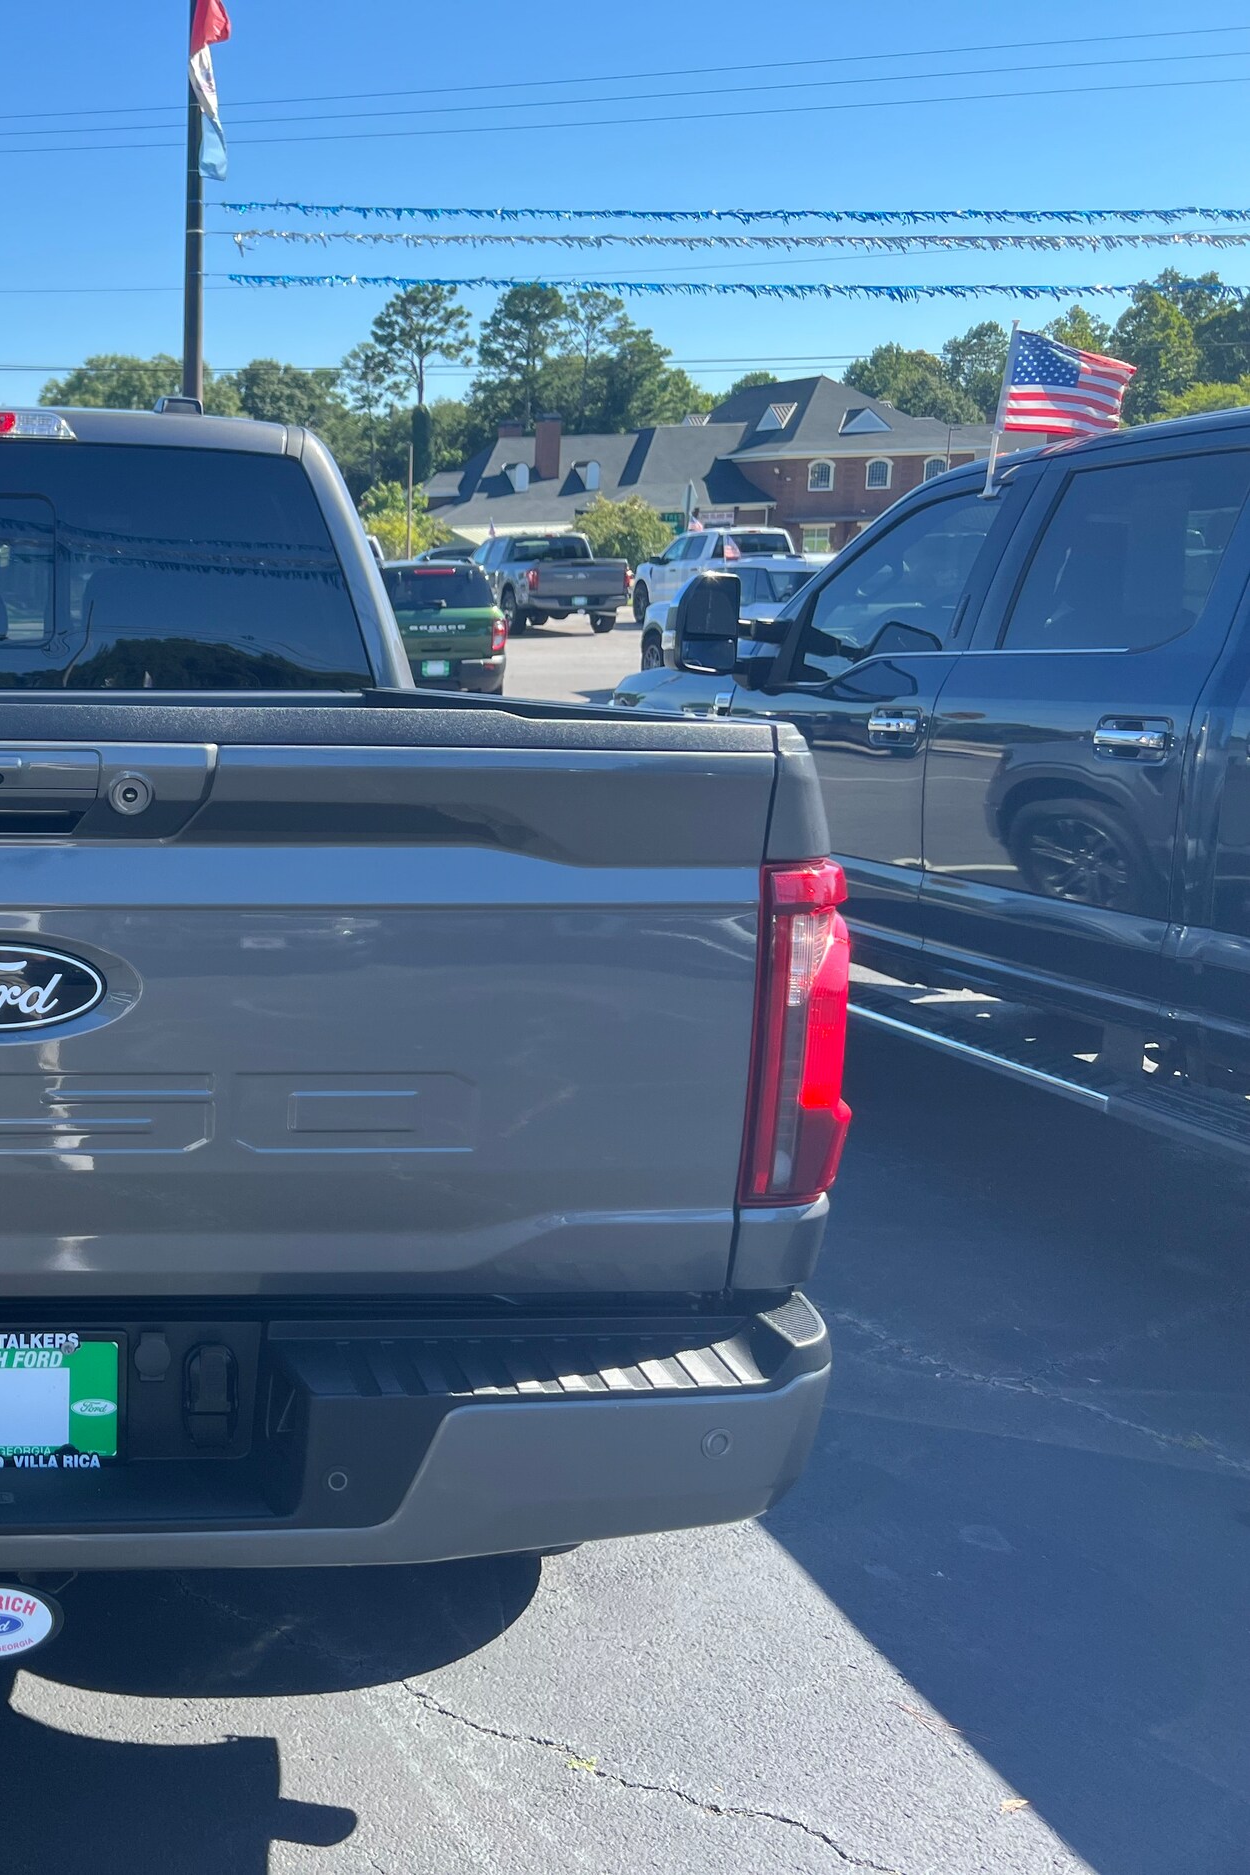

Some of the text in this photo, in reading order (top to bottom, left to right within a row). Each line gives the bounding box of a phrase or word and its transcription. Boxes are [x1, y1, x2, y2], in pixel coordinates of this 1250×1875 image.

[12, 1350, 64, 1368] FORD
[80, 1400, 108, 1414] Ford
[13, 1454, 59, 1469] VILLA
[63, 1453, 101, 1469] RICA
